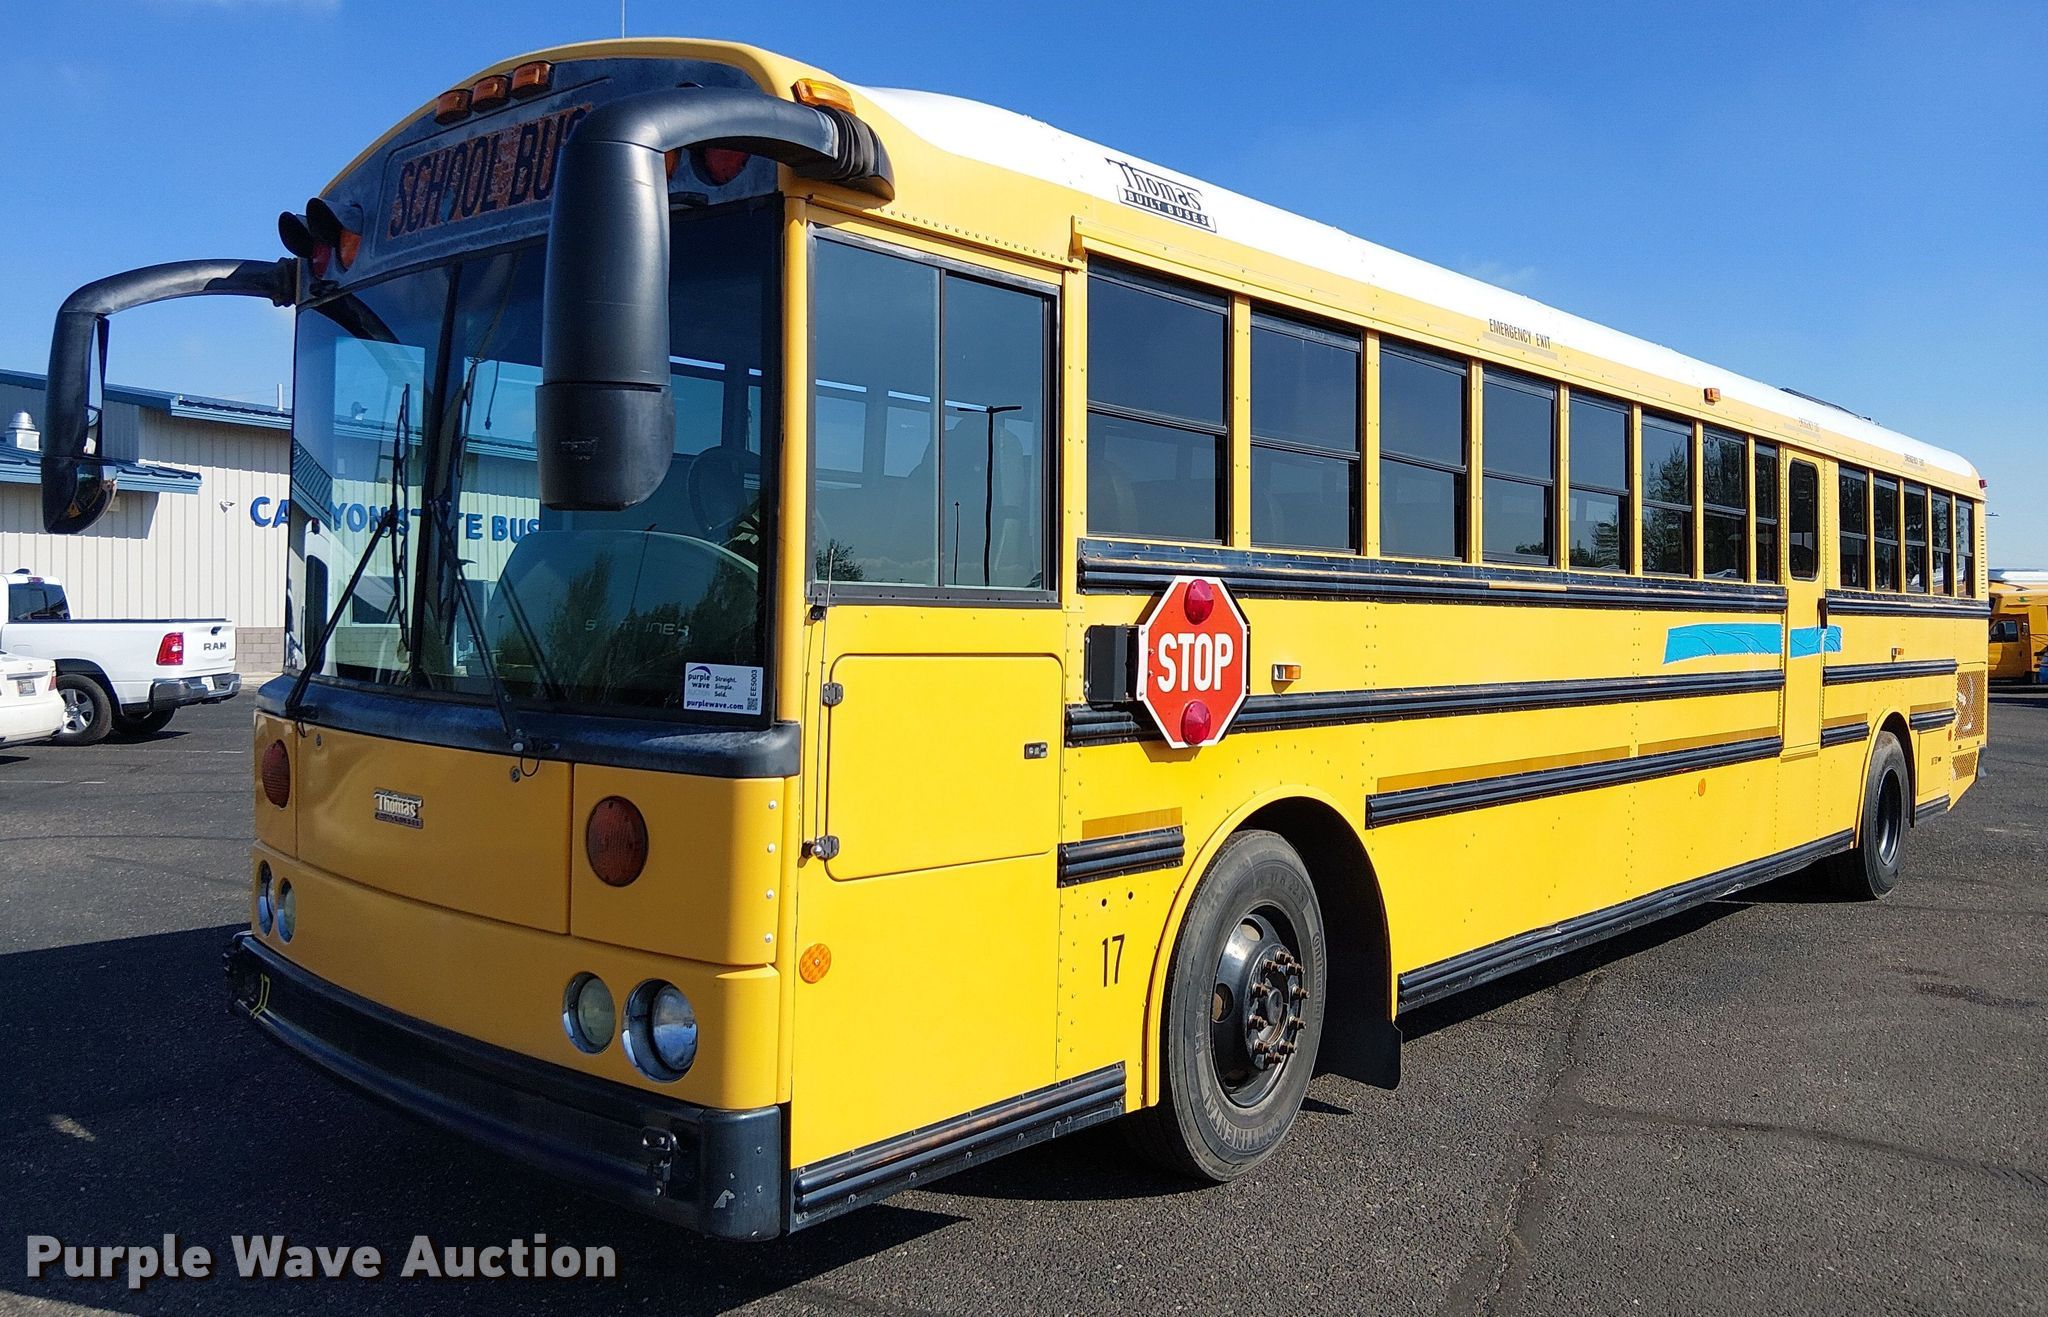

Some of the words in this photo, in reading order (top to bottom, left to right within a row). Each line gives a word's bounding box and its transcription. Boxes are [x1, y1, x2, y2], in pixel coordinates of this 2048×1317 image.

[390, 133, 501, 237] SCHOOL
[1104, 157, 1203, 211] Thomas
[1127, 190, 1163, 211] BUILT
[1168, 205, 1208, 226] BUSES
[1489, 318, 1532, 345] EMERGENCY
[1536, 332, 1551, 350] EXIT
[249, 496, 390, 534] CAYON
[203, 641, 227, 651] RAM
[1156, 632, 1234, 693] STOP
[687, 672, 711, 681] purple
[691, 681, 710, 689] wave
[686, 699, 744, 710] purplewave.com
[374, 793, 422, 818] Thomas
[1101, 933, 1125, 988] 17
